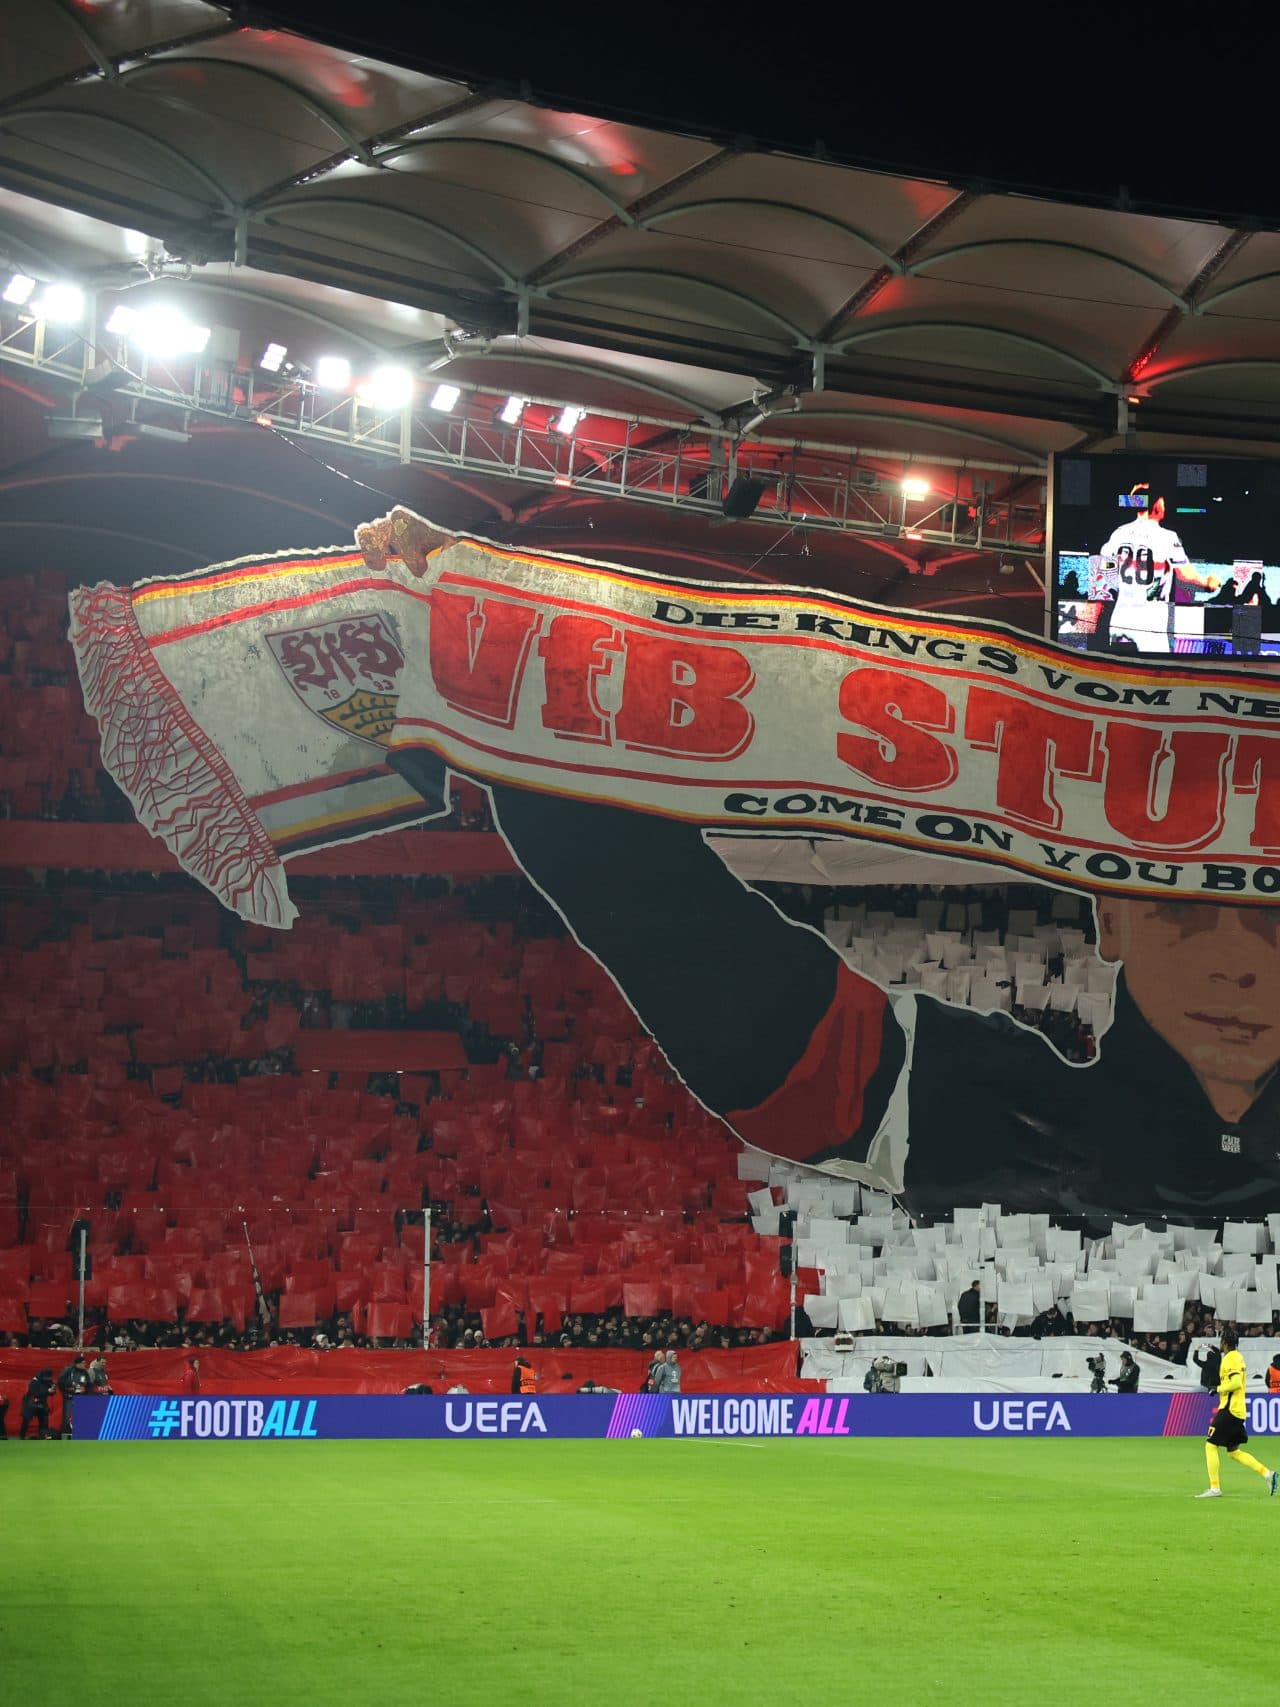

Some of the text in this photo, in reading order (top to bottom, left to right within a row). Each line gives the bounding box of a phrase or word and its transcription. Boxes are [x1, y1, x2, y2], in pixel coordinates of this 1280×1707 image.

[652, 600, 780, 630] DIE
[795, 613, 1018, 675] KINGS
[1037, 664, 1172, 706] VOM
[323, 679, 395, 701] 18 93
[723, 792, 906, 830] COME
[915, 814, 1014, 852] ON
[1038, 842, 1183, 886] YOU
[147, 1400, 318, 1437] #FOOTBALL
[446, 1402, 547, 1433] UEFA
[672, 1398, 850, 1435] WELCOME ALL
[974, 1400, 1072, 1431] UEFA
